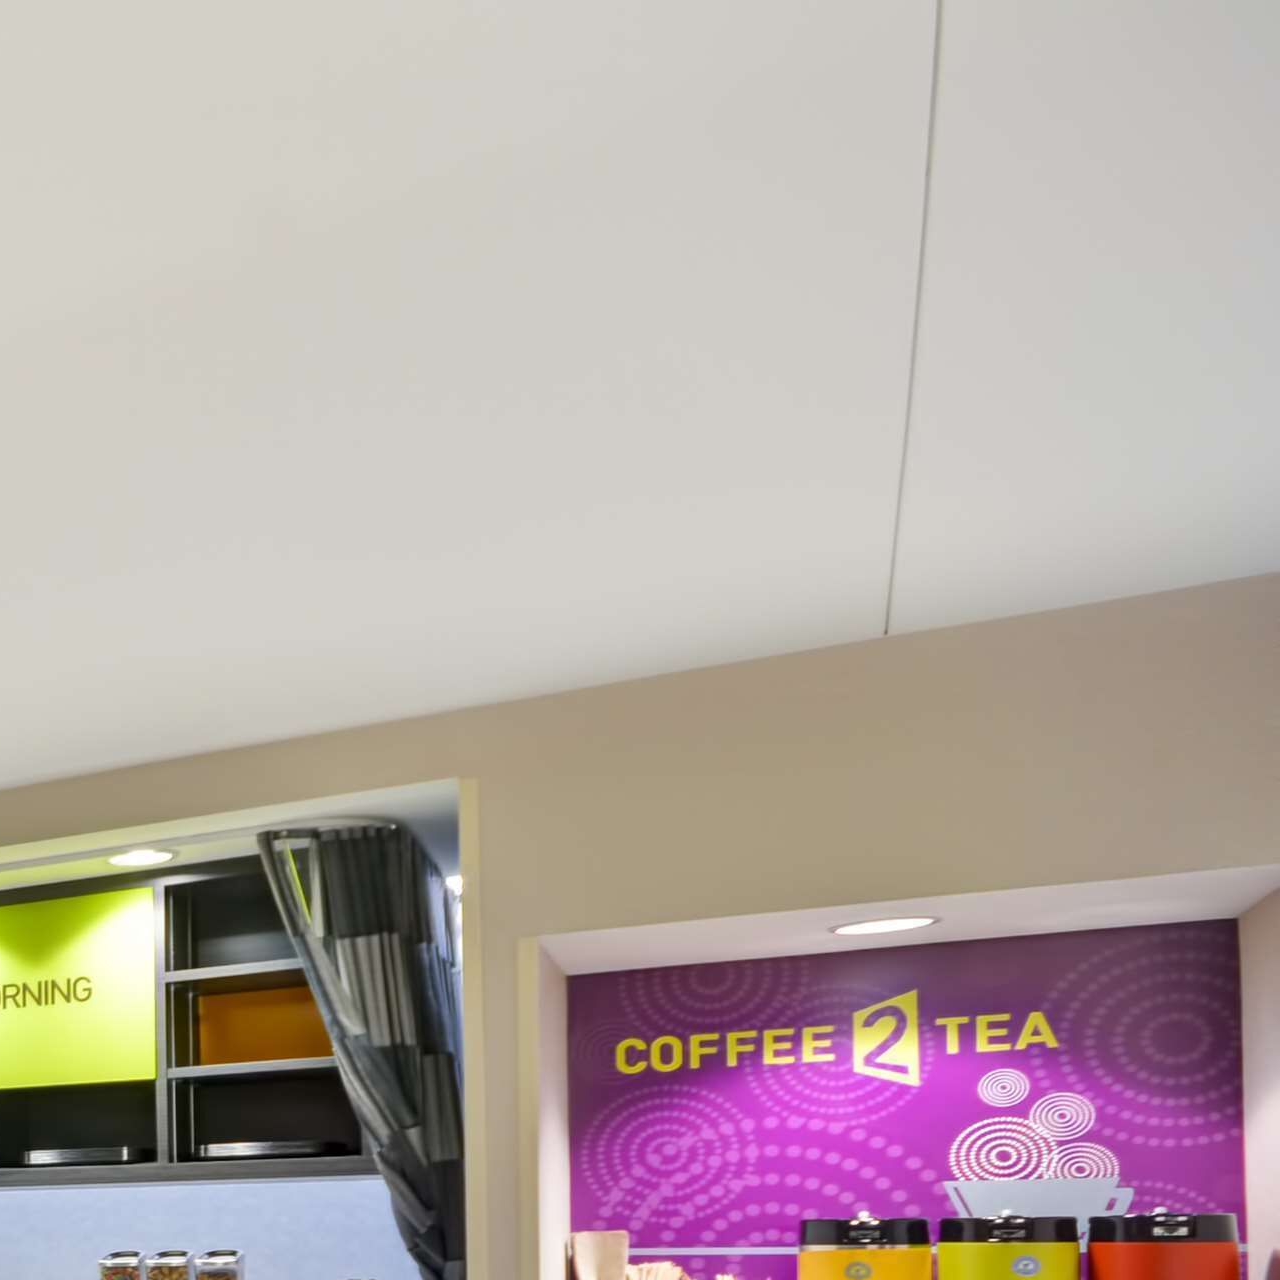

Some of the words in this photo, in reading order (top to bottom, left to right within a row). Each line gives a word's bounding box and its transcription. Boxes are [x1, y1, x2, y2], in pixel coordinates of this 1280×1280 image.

[614, 1025, 836, 1076] COFFEE
[859, 1003, 913, 1075] 2
[935, 1011, 1060, 1055] TEA
